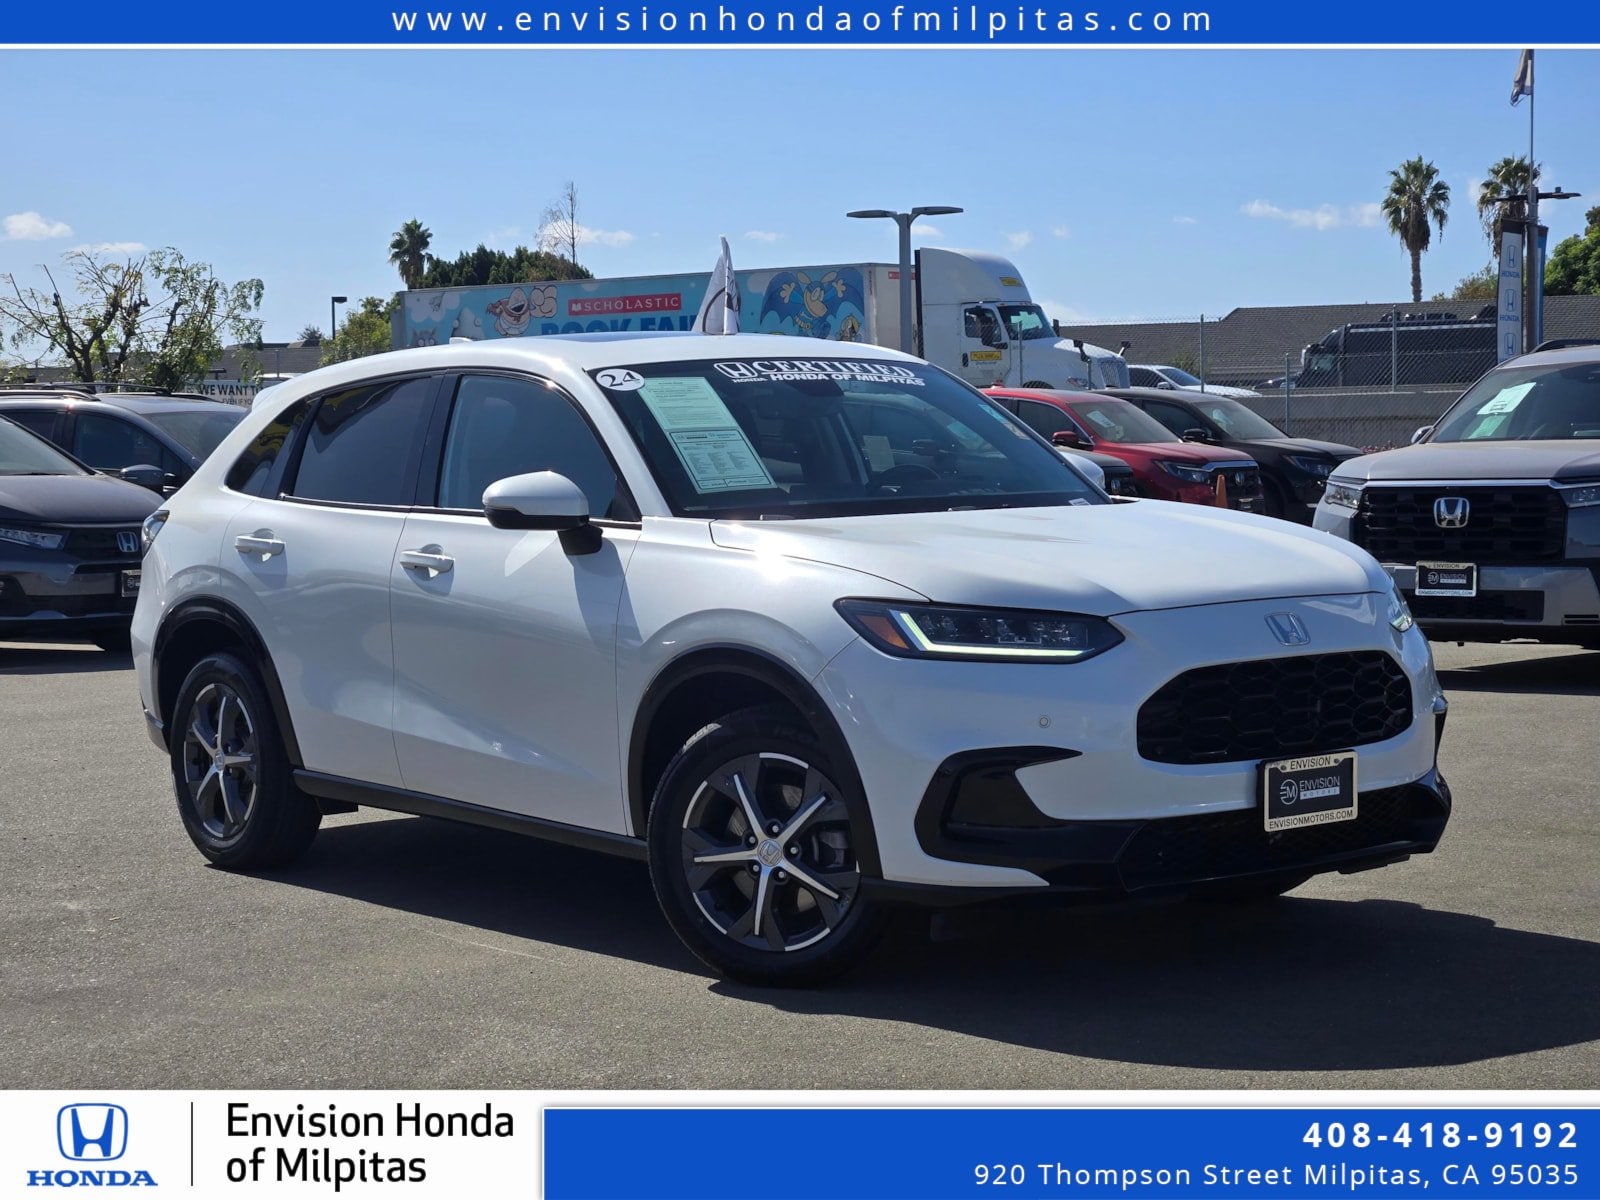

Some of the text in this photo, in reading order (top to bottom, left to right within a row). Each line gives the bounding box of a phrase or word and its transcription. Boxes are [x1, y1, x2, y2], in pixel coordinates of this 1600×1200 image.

[584, 297, 680, 312] SCHOLASTIC
[752, 361, 915, 378] CERTIFIED
[600, 371, 641, 387] 24
[771, 373, 827, 381] HONDA
[855, 374, 926, 386] MILPITAS
[201, 384, 216, 396] WE
[217, 384, 250, 396] WANT
[1290, 756, 1331, 770] ENVISION
[1299, 776, 1340, 791] ENVISION
[1302, 789, 1338, 798] MOTORS
[1269, 809, 1354, 830] ENVISIONMOTORS.COM
